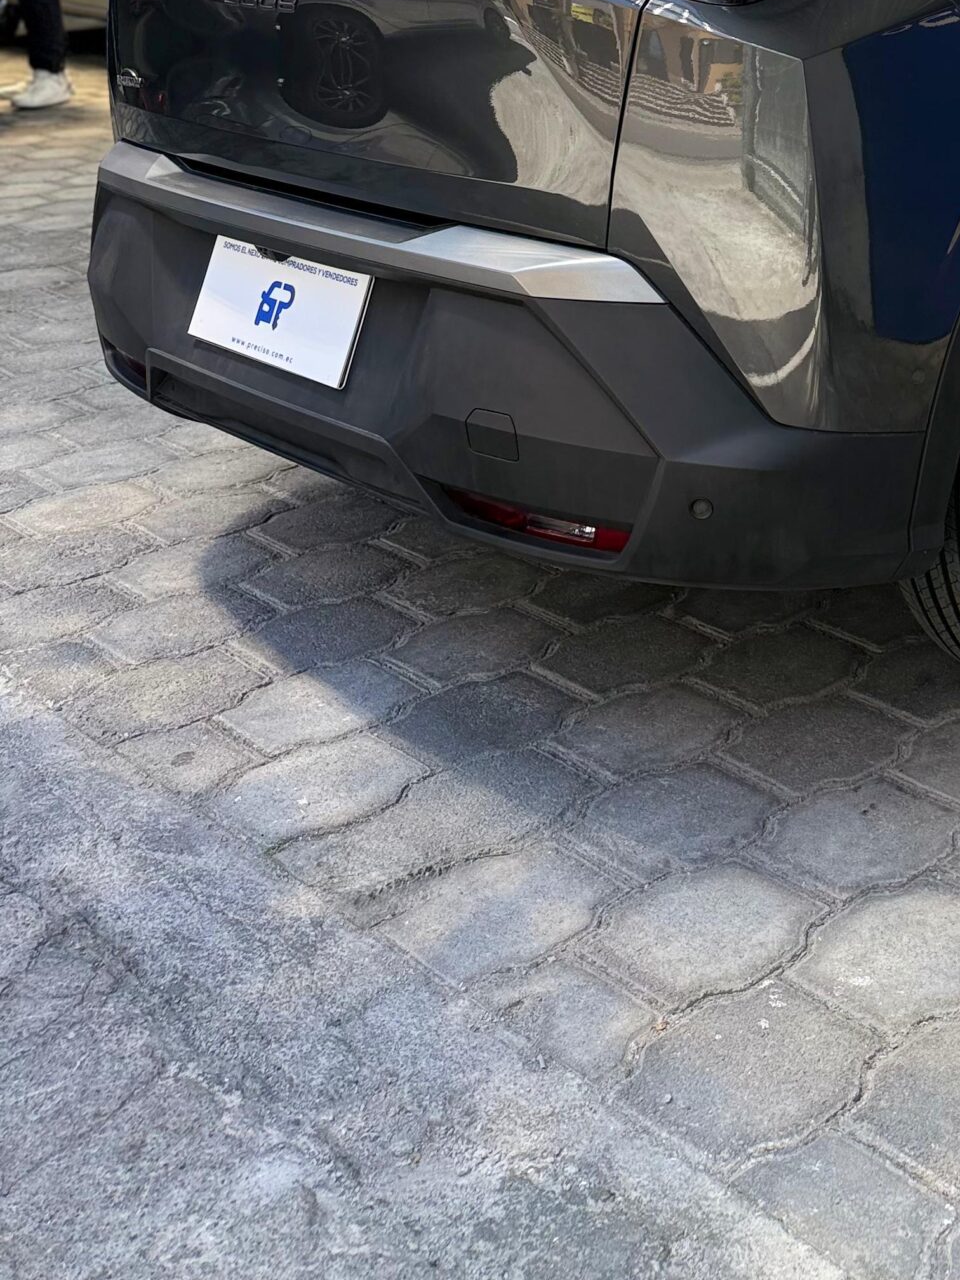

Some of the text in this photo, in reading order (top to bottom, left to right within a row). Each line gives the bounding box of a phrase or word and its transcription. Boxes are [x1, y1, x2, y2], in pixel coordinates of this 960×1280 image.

[223, 240, 241, 253] SOMOS
[240, 245, 248, 255] EL
[321, 270, 359, 287] VENDEDORES
[231, 336, 294, 364] www.preciso.com.ec
